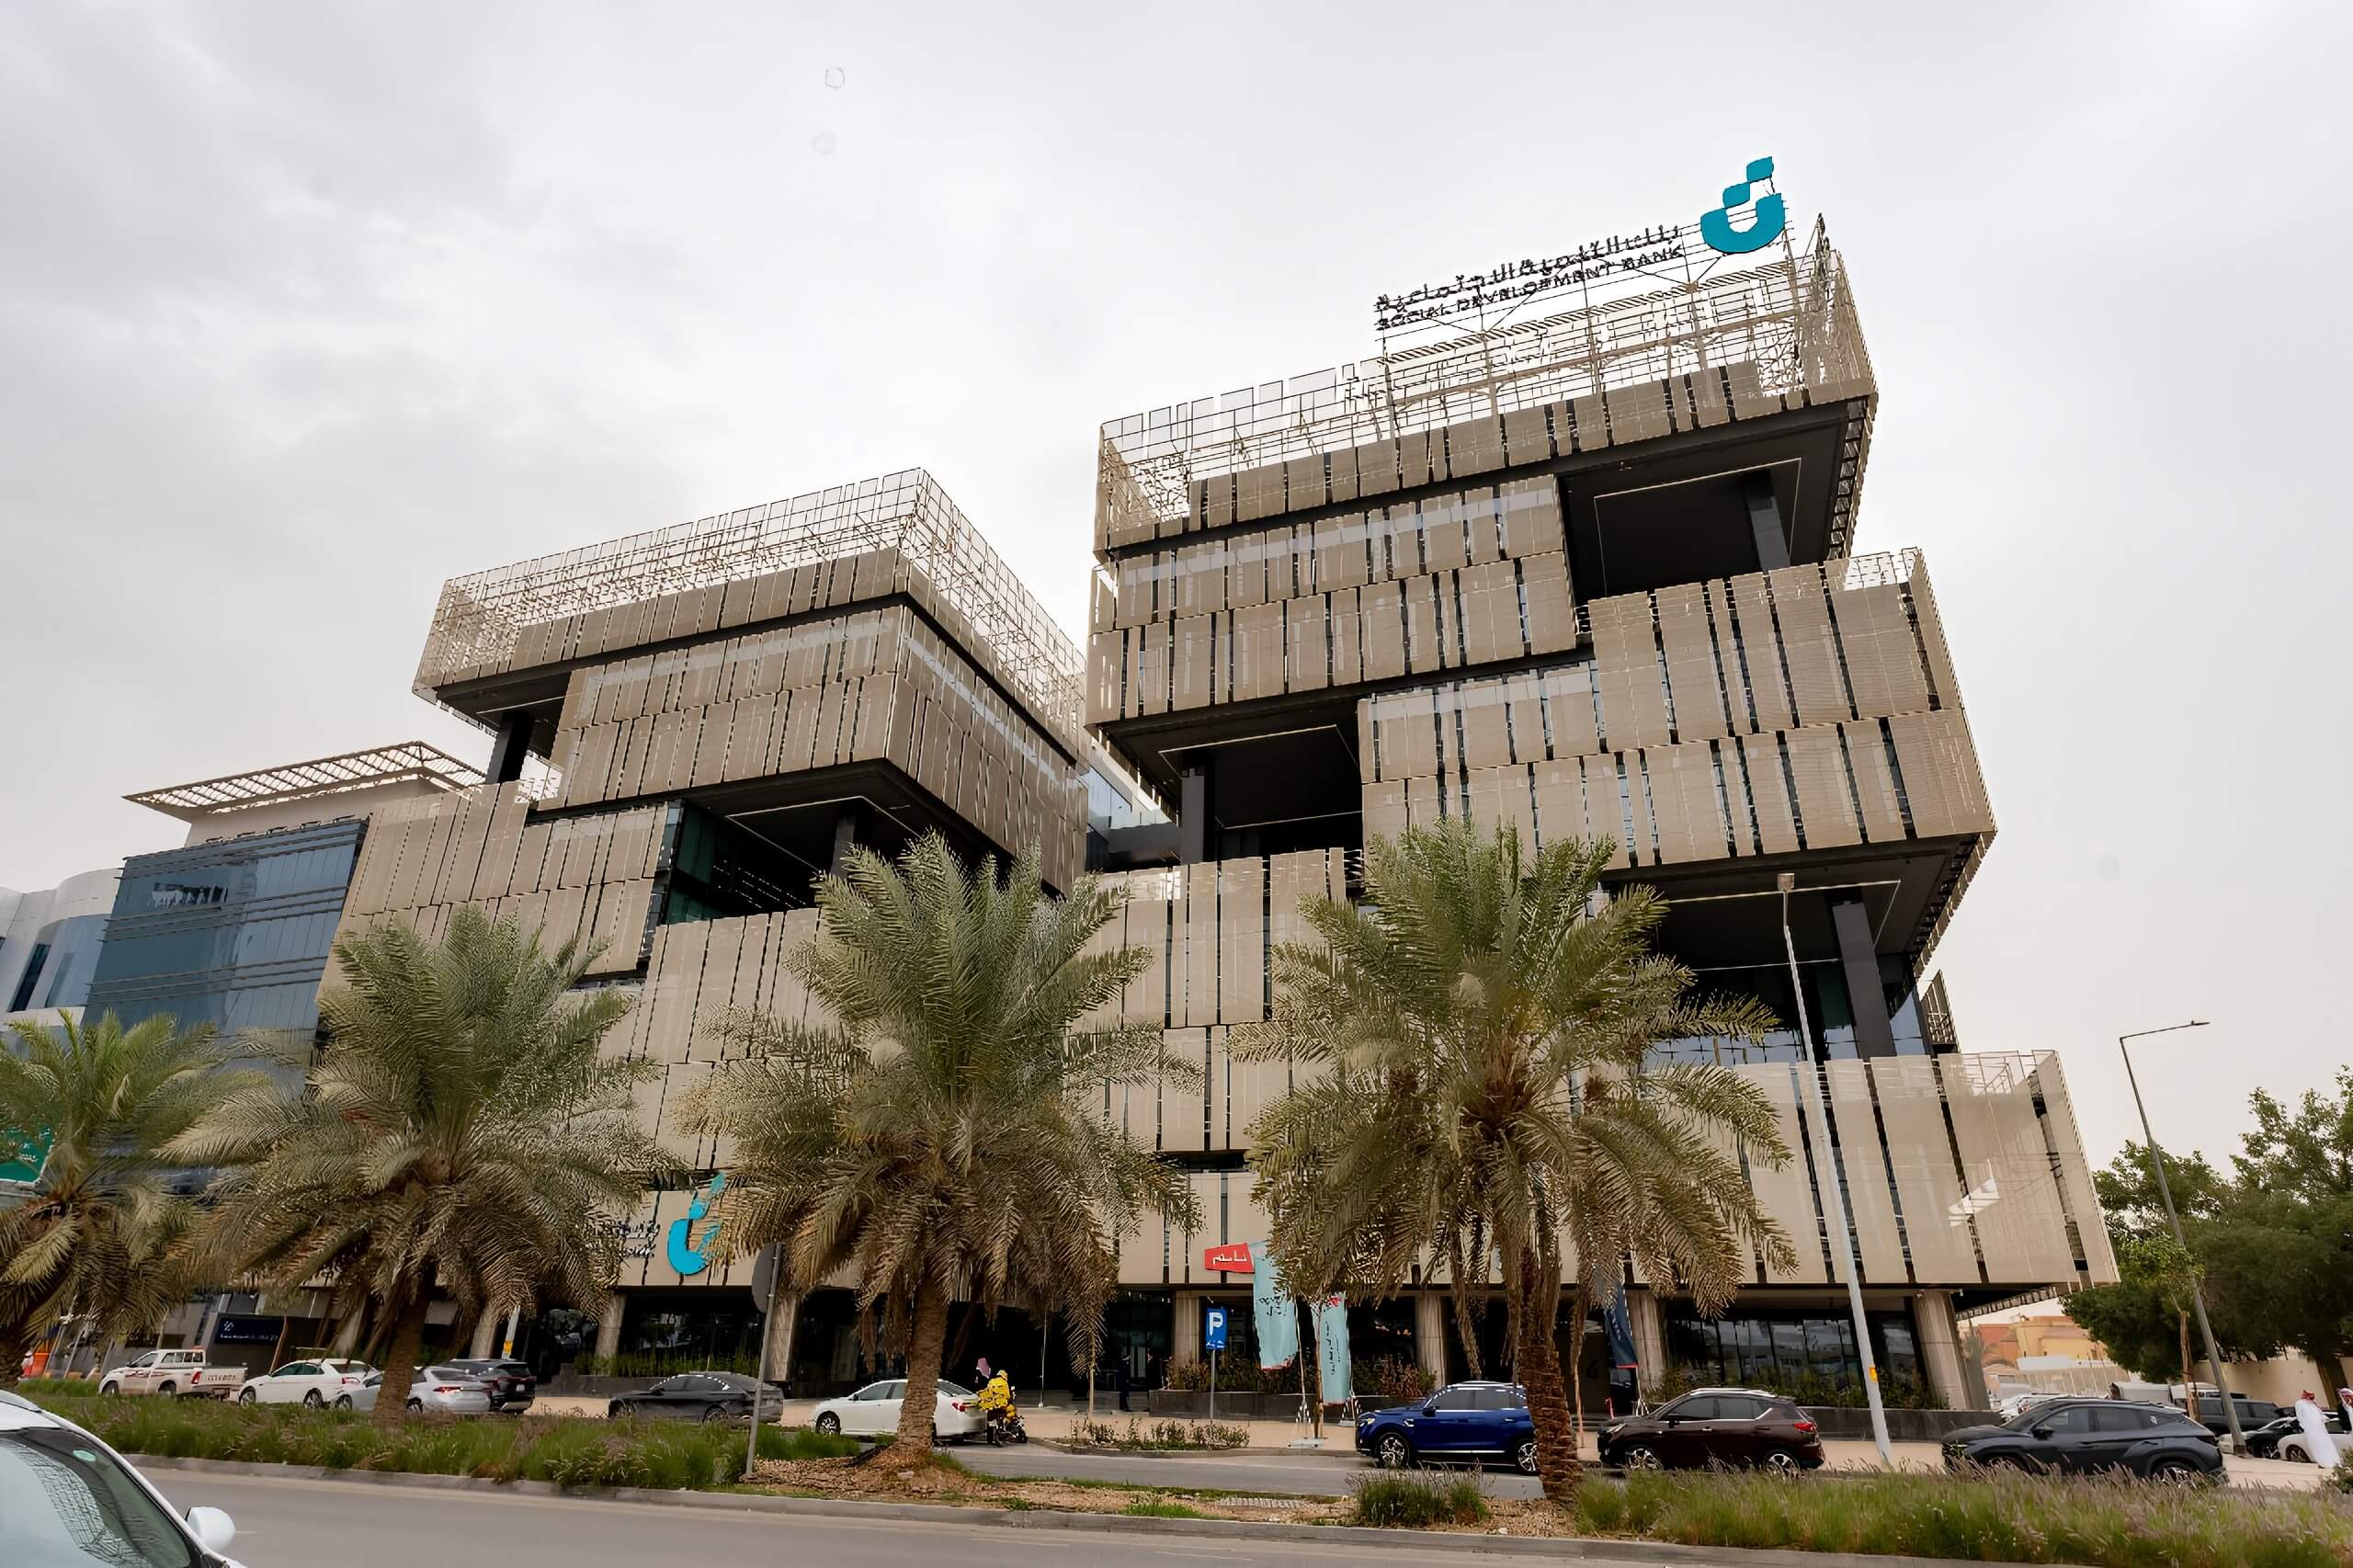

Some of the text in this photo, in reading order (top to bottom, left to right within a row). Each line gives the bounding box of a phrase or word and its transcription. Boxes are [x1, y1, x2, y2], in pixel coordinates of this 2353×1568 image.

[1376, 303, 1451, 331] SOCIAL
[1621, 244, 1685, 270] BANK
[1209, 1312, 1223, 1336] P
